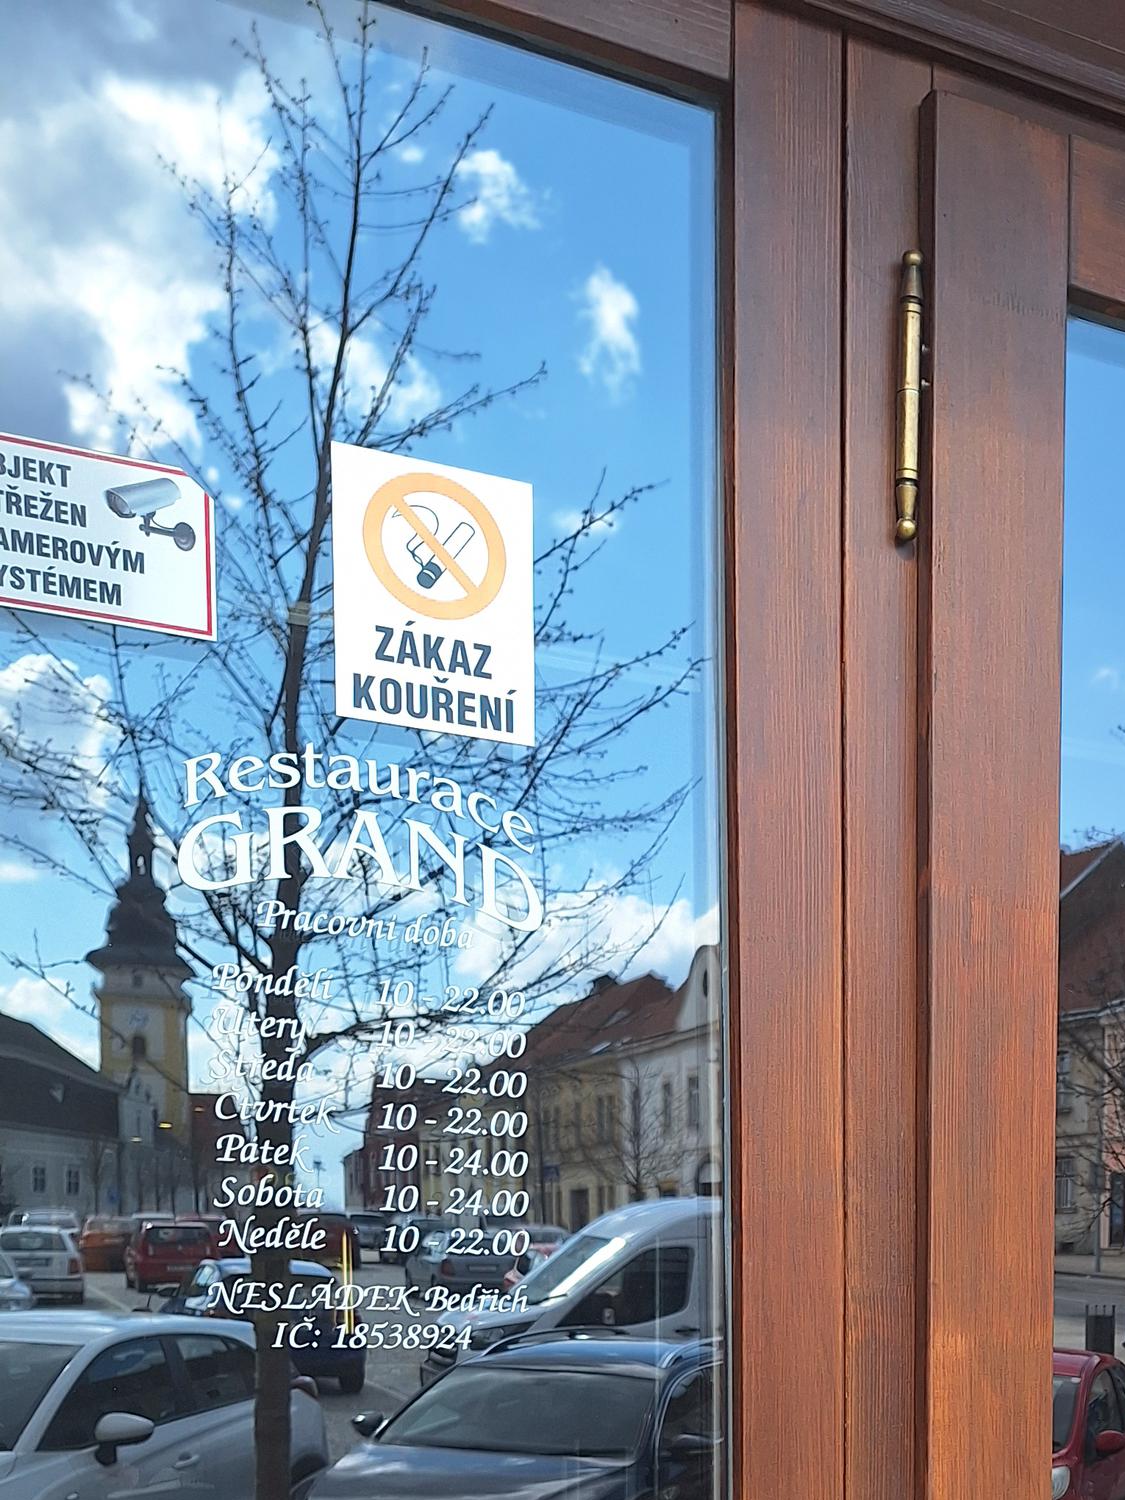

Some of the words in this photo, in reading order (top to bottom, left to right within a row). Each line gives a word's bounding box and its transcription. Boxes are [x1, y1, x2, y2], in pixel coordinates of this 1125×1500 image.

[0, 484, 86, 528] ŘEŽEN
[374, 620, 493, 680] ZÁKAZ
[352, 672, 518, 734] KOUŘENÍ
[183, 742, 536, 855] Restaurace
[177, 805, 544, 933] GRAND
[403, 913, 474, 950] doba
[375, 979, 414, 1007] 10
[440, 985, 526, 1018] 22.00
[376, 1020, 415, 1048] 10
[442, 1026, 527, 1058] 22.00
[209, 1049, 315, 1081] Středa
[376, 1062, 416, 1091] 10
[441, 1067, 528, 1099] 22.00
[377, 1103, 417, 1132] 10
[442, 1107, 529, 1138] 22.00
[215, 1133, 315, 1173] Pátek
[378, 1143, 419, 1172] 10
[443, 1147, 529, 1178] 24.00
[212, 1173, 325, 1209] Sobota
[379, 1185, 419, 1213] 10
[444, 1188, 530, 1218] 24.00
[217, 1215, 327, 1254] Neděle
[380, 1225, 420, 1253] 10
[445, 1227, 531, 1258] 22.00
[207, 1277, 421, 1316] NESLÁDEK
[424, 1283, 530, 1313] Bedřich
[271, 1317, 322, 1350] IČ:
[331, 1320, 473, 1351] 18538924
